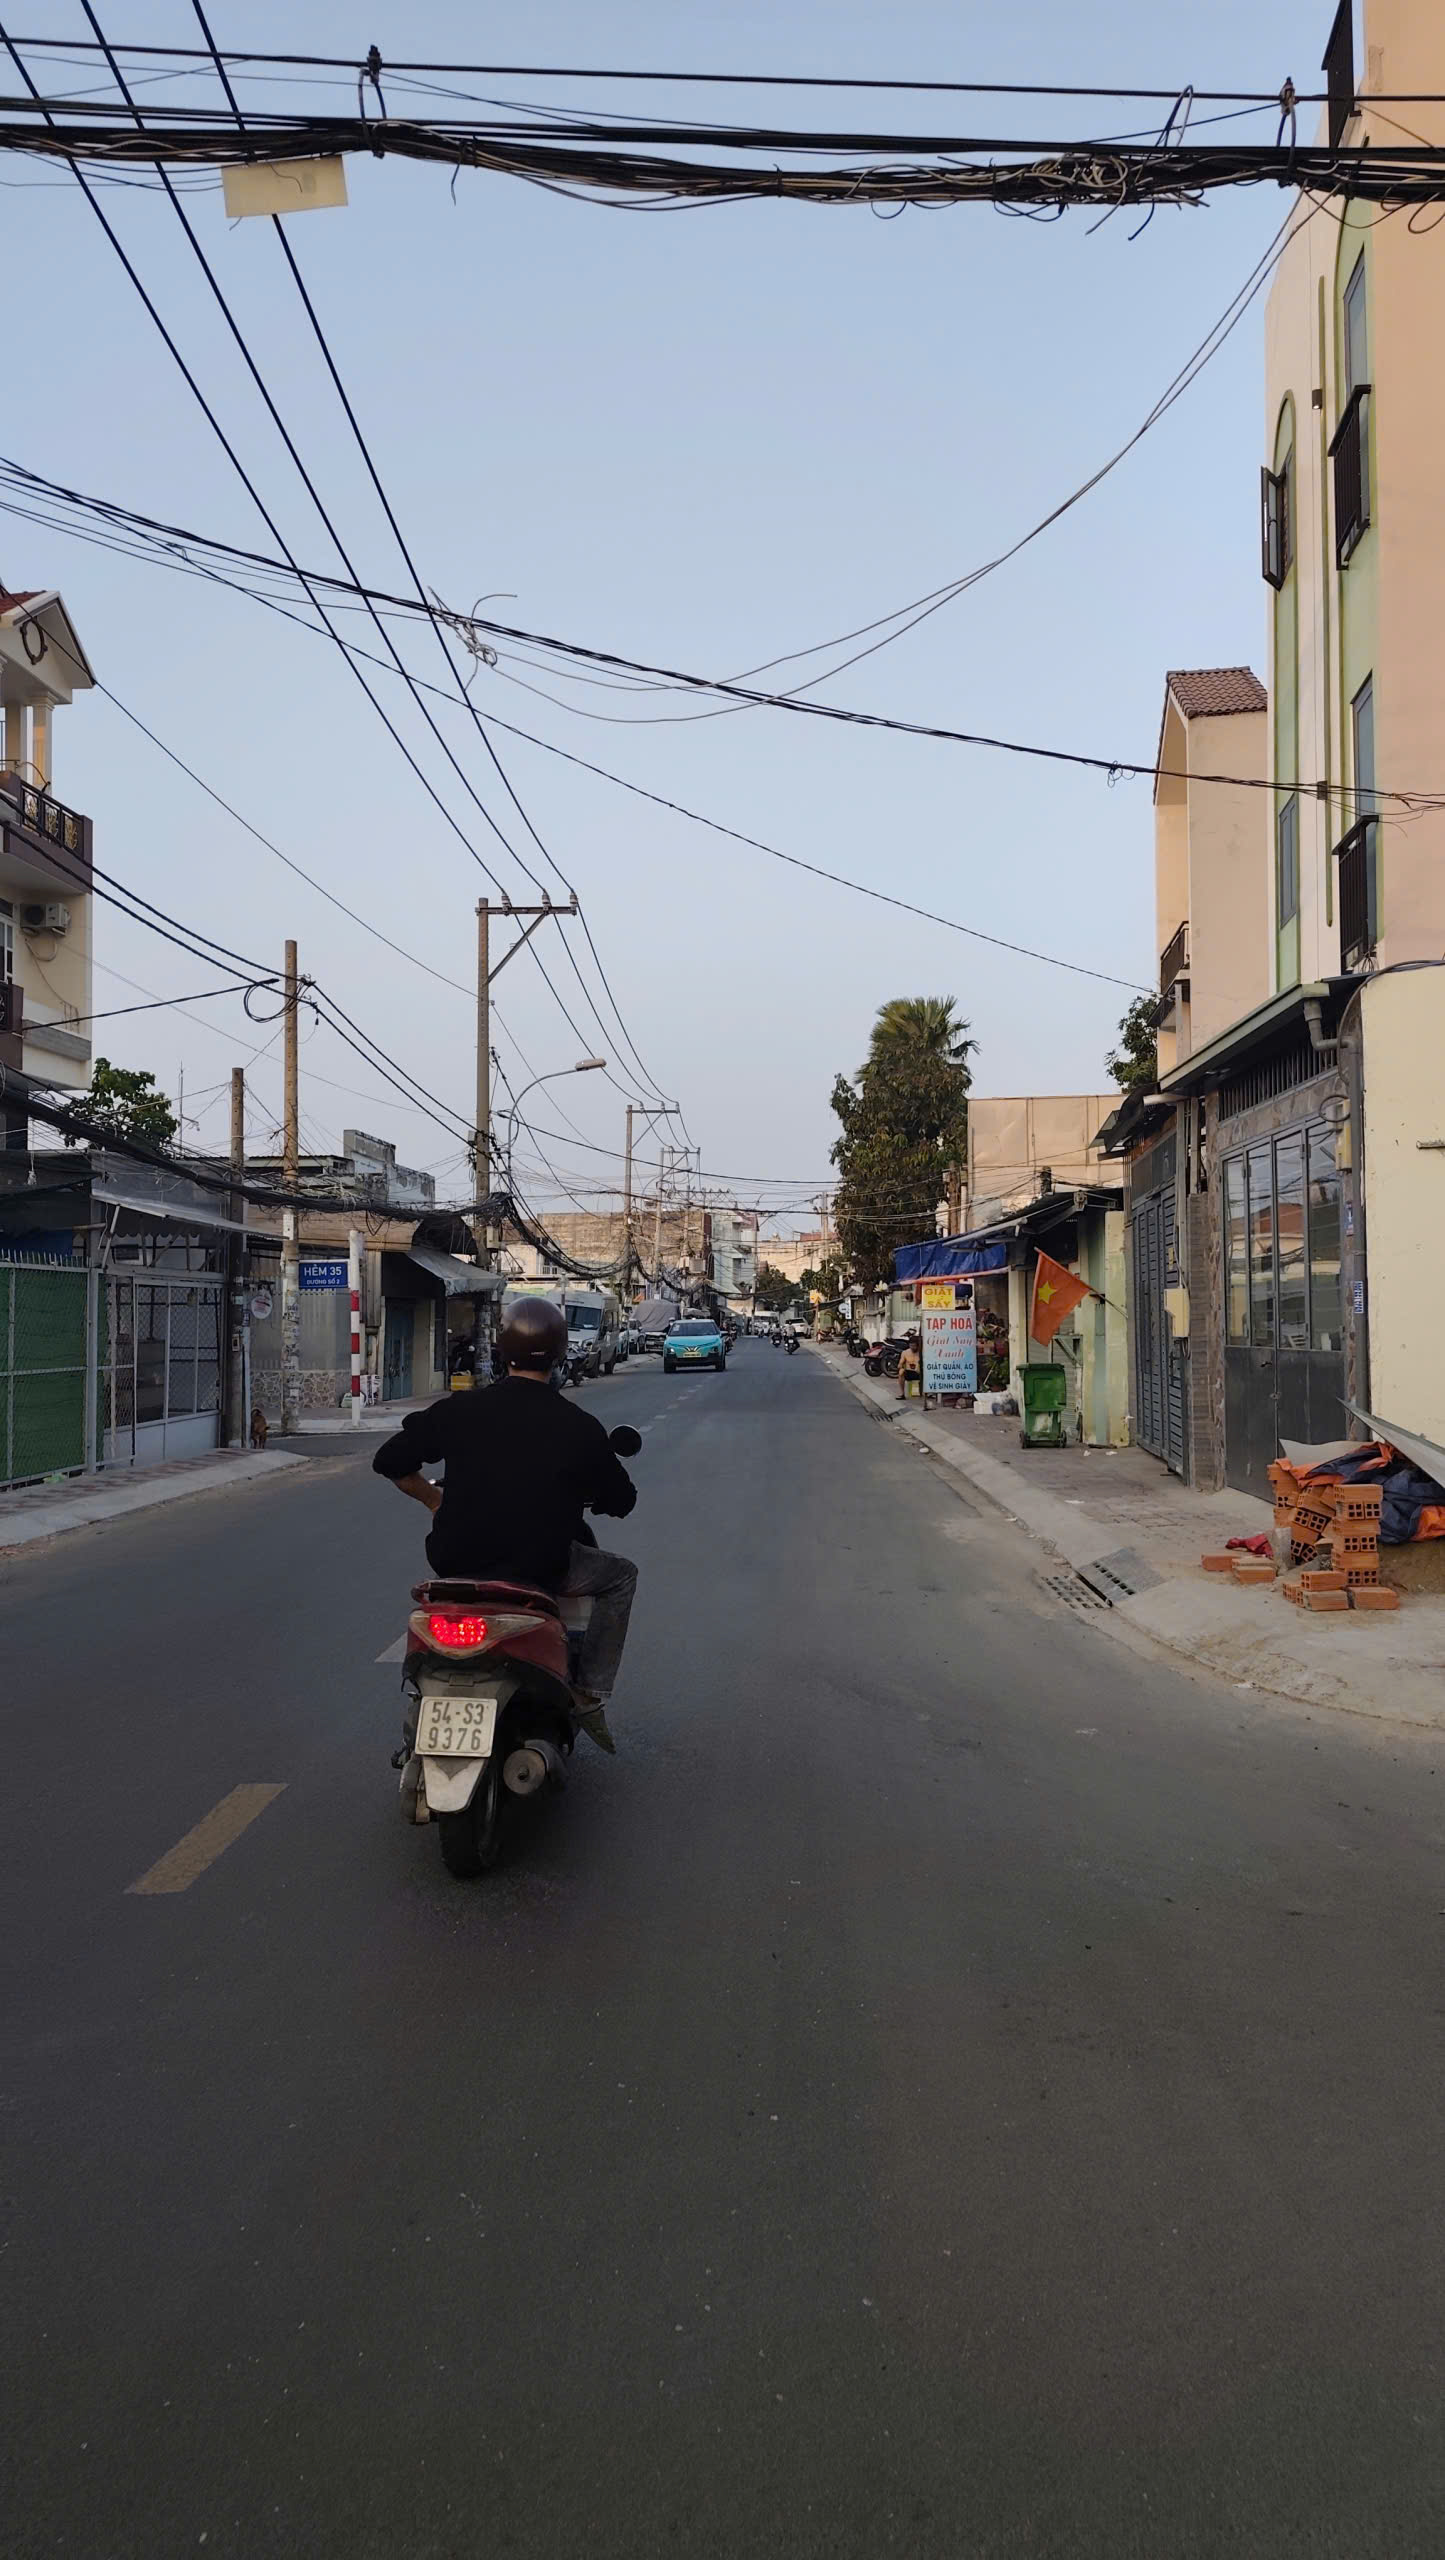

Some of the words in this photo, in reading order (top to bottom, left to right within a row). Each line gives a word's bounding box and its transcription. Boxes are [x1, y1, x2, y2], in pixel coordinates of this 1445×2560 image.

[329, 1266, 342, 1276] 35
[926, 1317, 946, 1332] TẠP
[431, 1701, 485, 1725] 54-S3
[427, 1726, 483, 1751] 9376
